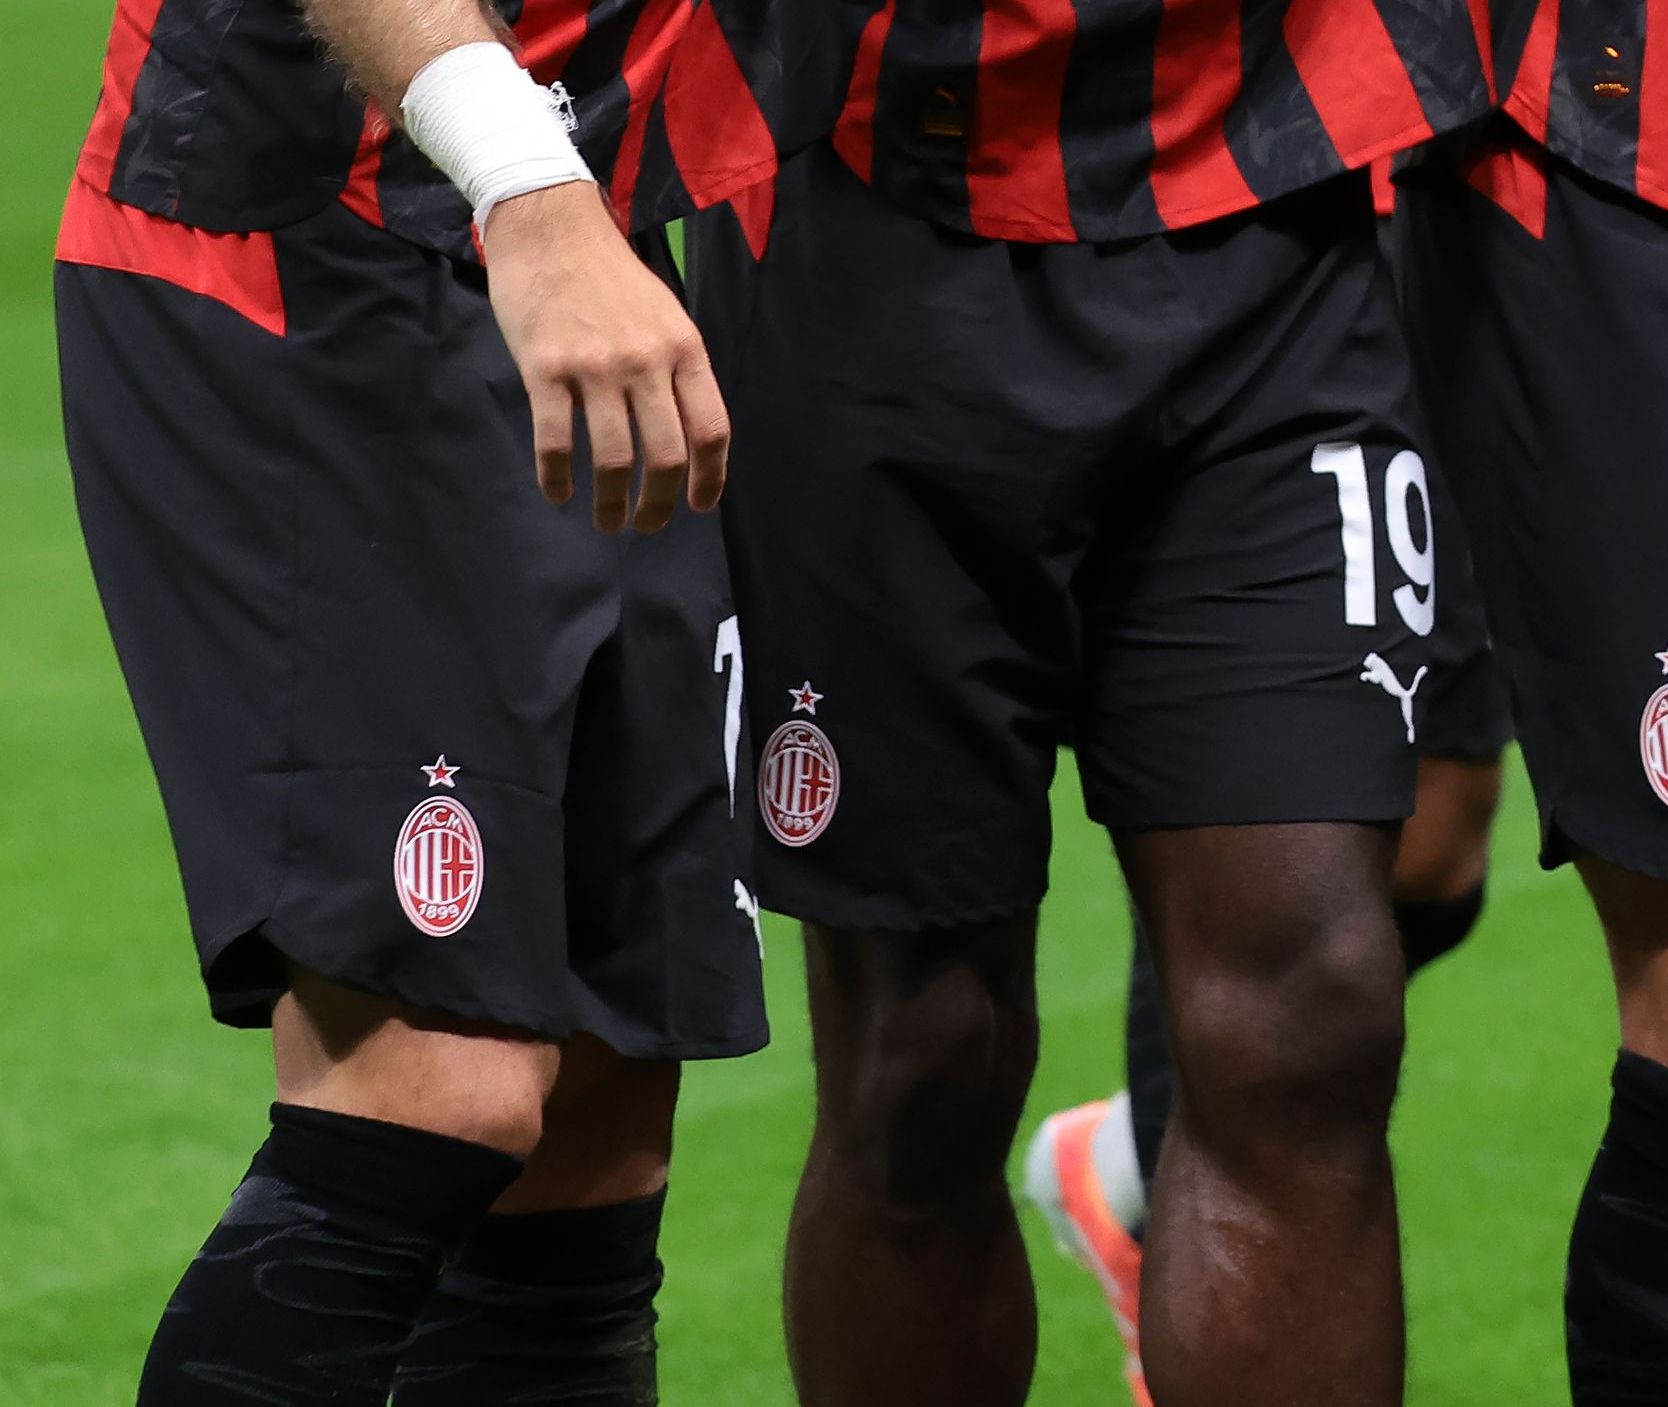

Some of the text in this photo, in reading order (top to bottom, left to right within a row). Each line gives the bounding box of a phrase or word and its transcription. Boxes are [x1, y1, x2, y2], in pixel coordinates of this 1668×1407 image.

[1311, 442, 1435, 637] 19
[415, 807, 464, 834] ACM
[417, 902, 461, 920] 1899
